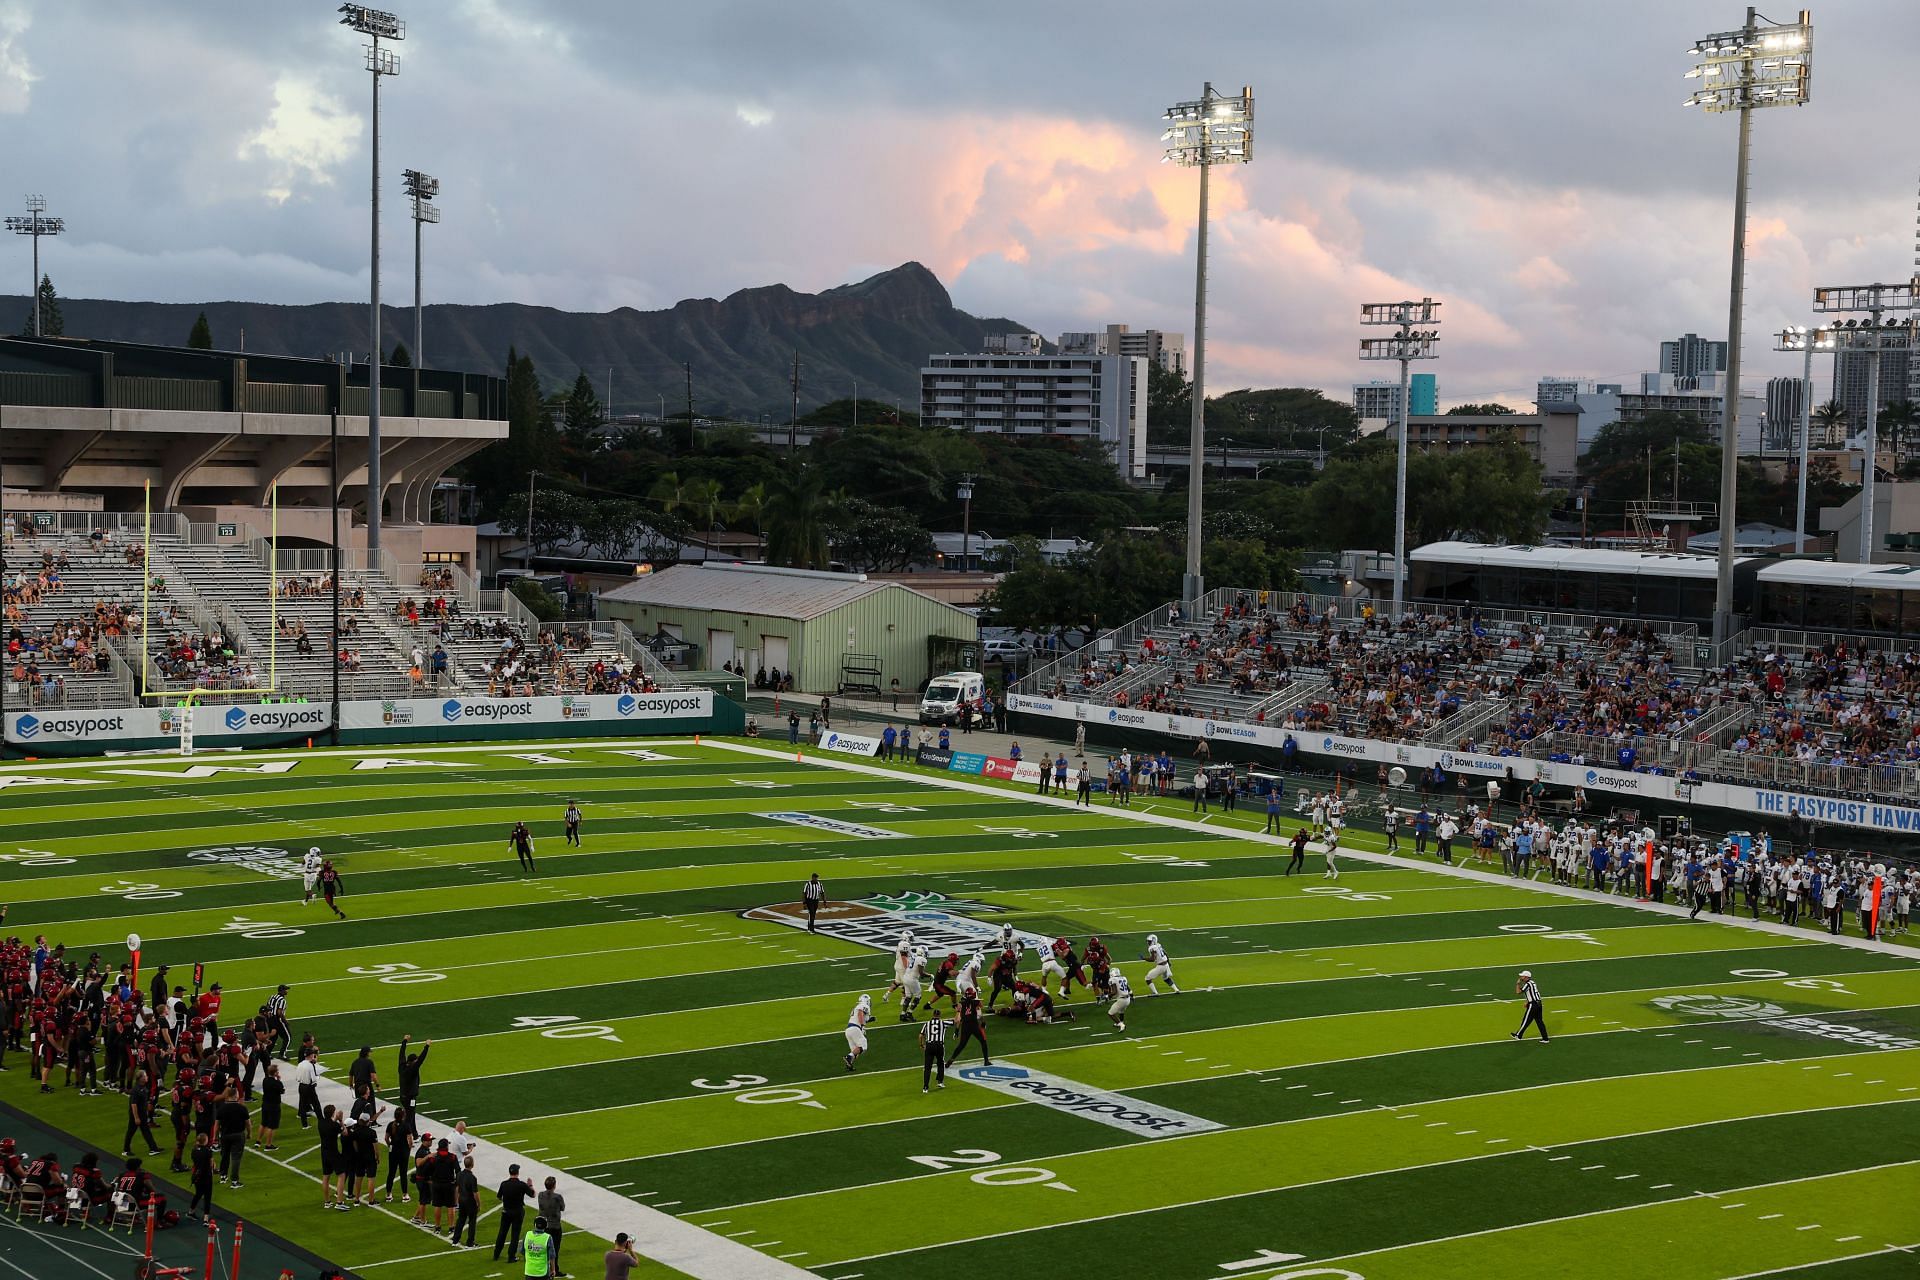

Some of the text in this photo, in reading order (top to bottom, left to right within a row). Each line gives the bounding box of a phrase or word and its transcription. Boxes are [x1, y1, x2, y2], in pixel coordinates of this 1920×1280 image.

[465, 702, 532, 720] easypost
[638, 697, 701, 715] easypost
[1018, 700, 1053, 711] BOWL SEASON
[43, 716, 124, 736] easypost
[250, 709, 324, 728] easypost
[1117, 712, 1145, 724] easypost
[1216, 726, 1257, 738] BOWL SEASON
[837, 739, 871, 752] easypost
[1333, 741, 1366, 754] easypost
[920, 751, 951, 763] TicketSmarter
[1454, 758, 1503, 770] BOWL SEASON
[1598, 775, 1638, 789] easypost
[1755, 791, 1784, 812] THE
[1787, 796, 1867, 824] EASYPOST
[982, 826, 1060, 839] 30
[307, 859, 313, 870] 2
[1131, 854, 1211, 867] 40
[99, 882, 184, 900] 30
[1301, 886, 1393, 901] 50
[219, 921, 306, 939] 40
[1497, 924, 1599, 941] 40
[346, 962, 448, 984] 50
[1728, 968, 1846, 990] 30
[510, 1015, 615, 1039] 40
[932, 1024, 939, 1034] C
[1757, 1019, 1905, 1050] SEASON
[1783, 1017, 1920, 1048] BOWL
[690, 1074, 814, 1105] 30
[1009, 1080, 1187, 1131] easypost
[905, 1149, 1058, 1186] 20
[120, 1176, 136, 1191] 77
